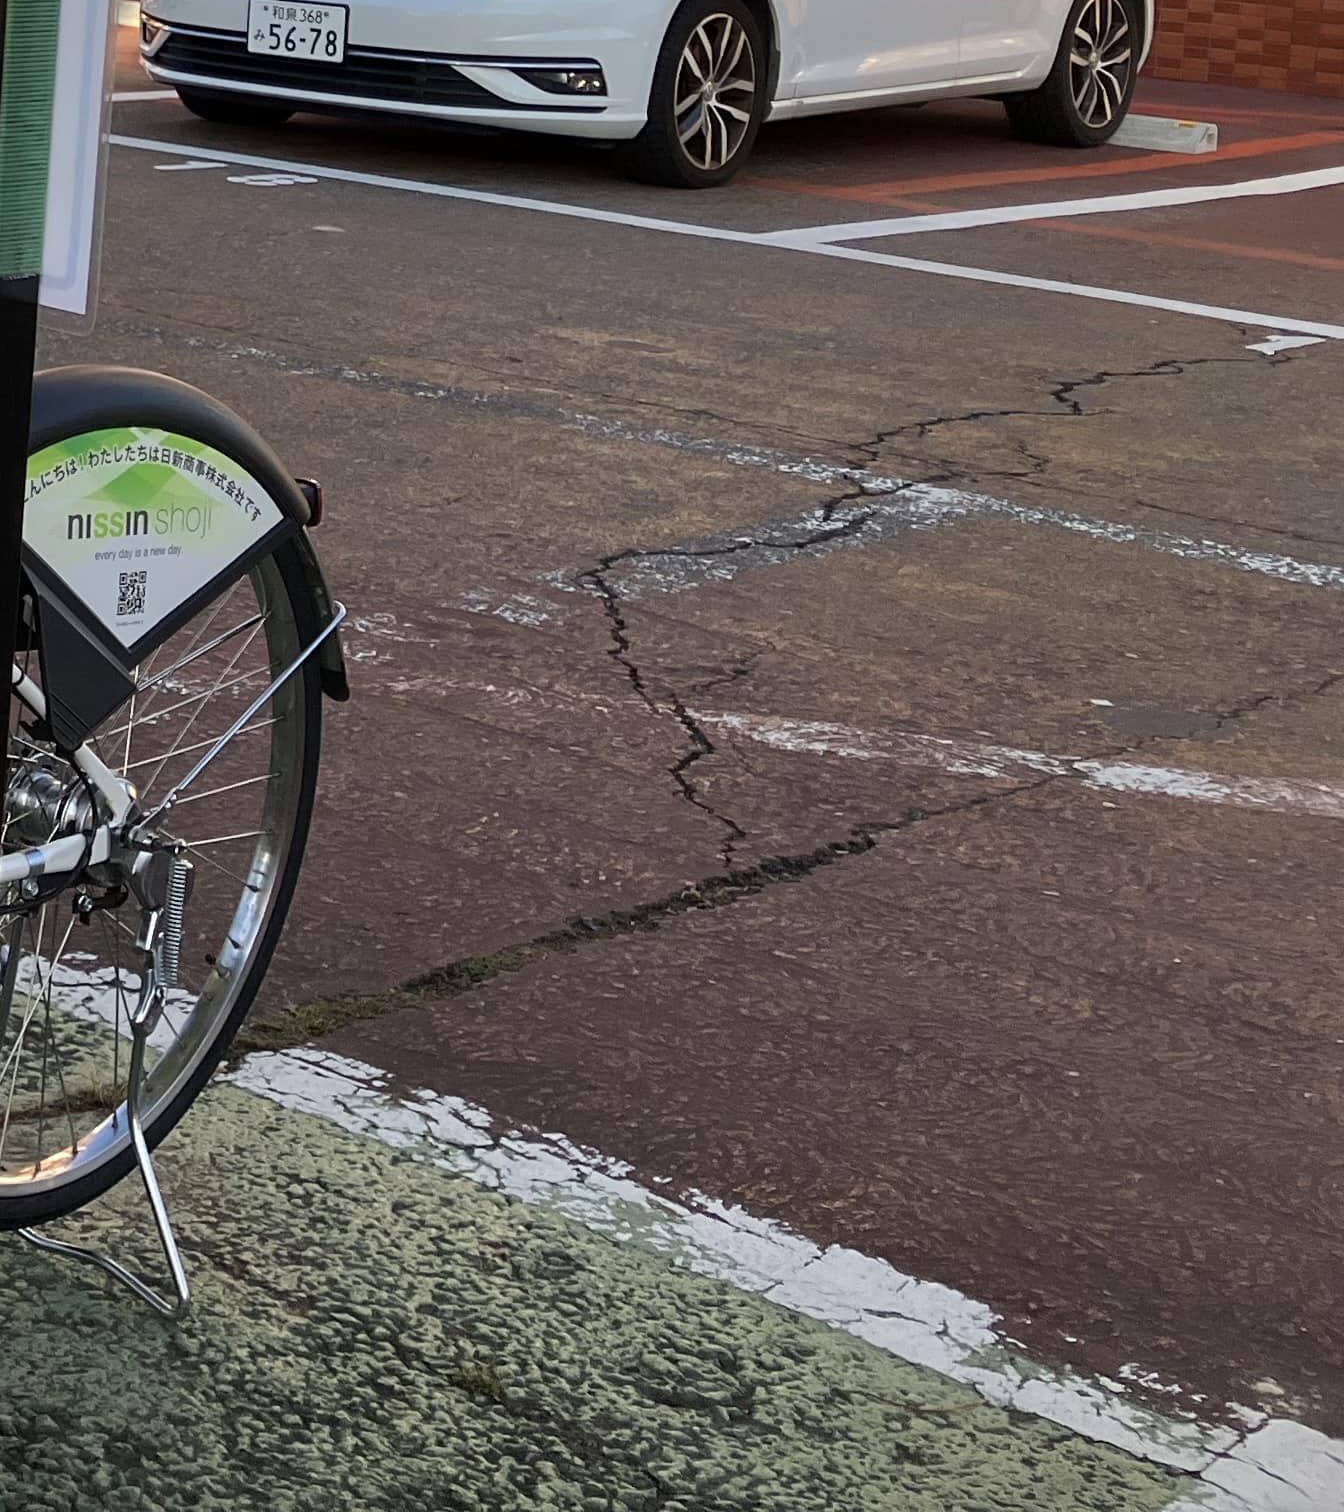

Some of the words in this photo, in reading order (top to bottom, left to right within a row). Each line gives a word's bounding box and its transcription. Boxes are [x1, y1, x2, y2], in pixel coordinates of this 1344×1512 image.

[268, 23, 338, 57] 56-78
[67, 509, 149, 540] nissin
[154, 504, 212, 539] shoji
[94, 550, 117, 561] every
[118, 548, 133, 560] day
[134, 546, 142, 558] is
[150, 546, 166, 556] new
[167, 544, 183, 557] day
